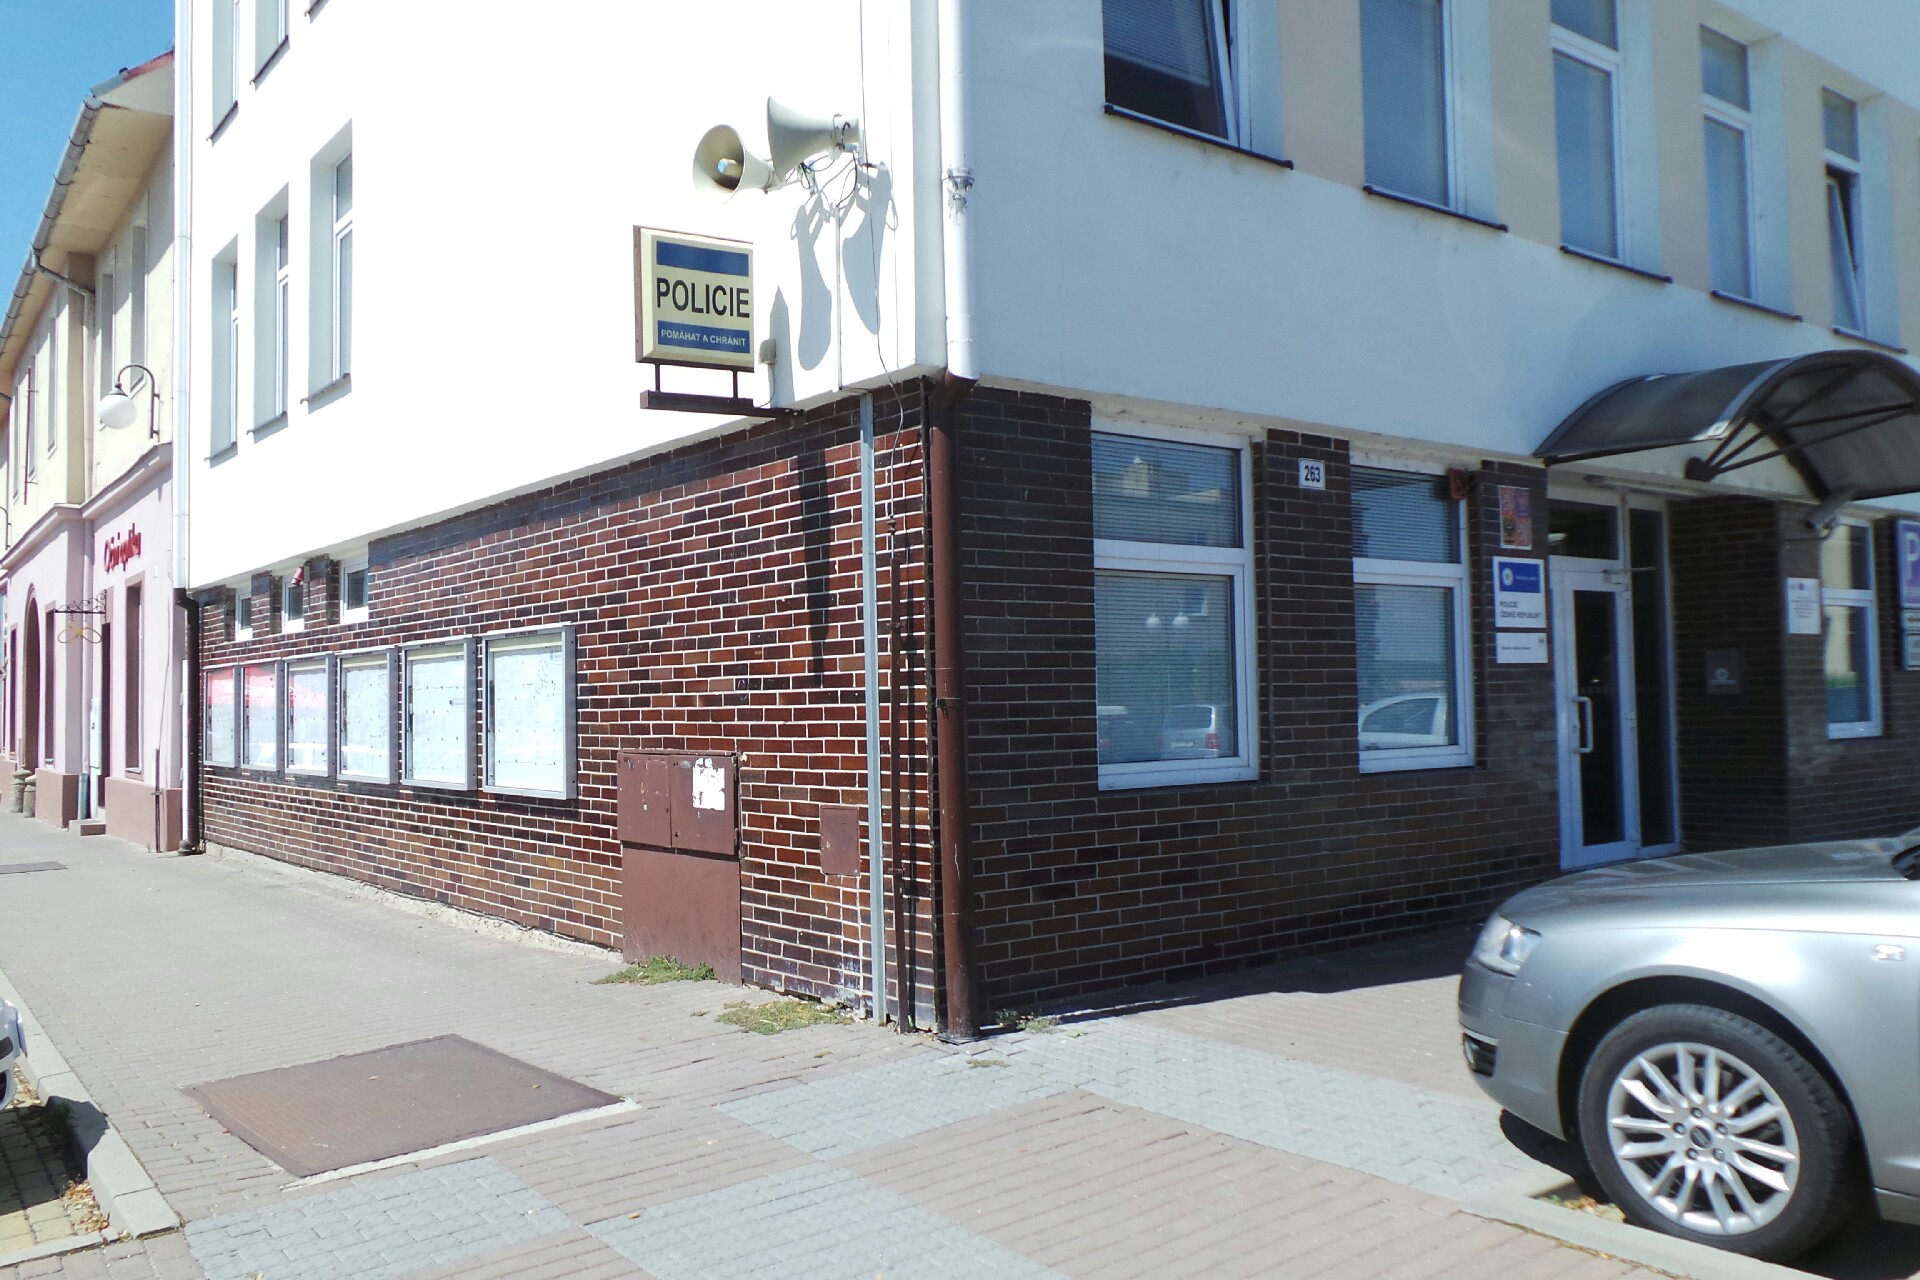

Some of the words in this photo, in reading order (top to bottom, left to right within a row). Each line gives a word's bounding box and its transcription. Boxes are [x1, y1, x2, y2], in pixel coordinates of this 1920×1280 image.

[656, 277, 750, 319] POLICIE
[661, 329, 701, 342] POMÁHAT
[702, 334, 708, 343] A
[709, 335, 746, 347] CHRÁNIT
[1304, 465, 1321, 483] 263
[1905, 532, 1920, 583] P
